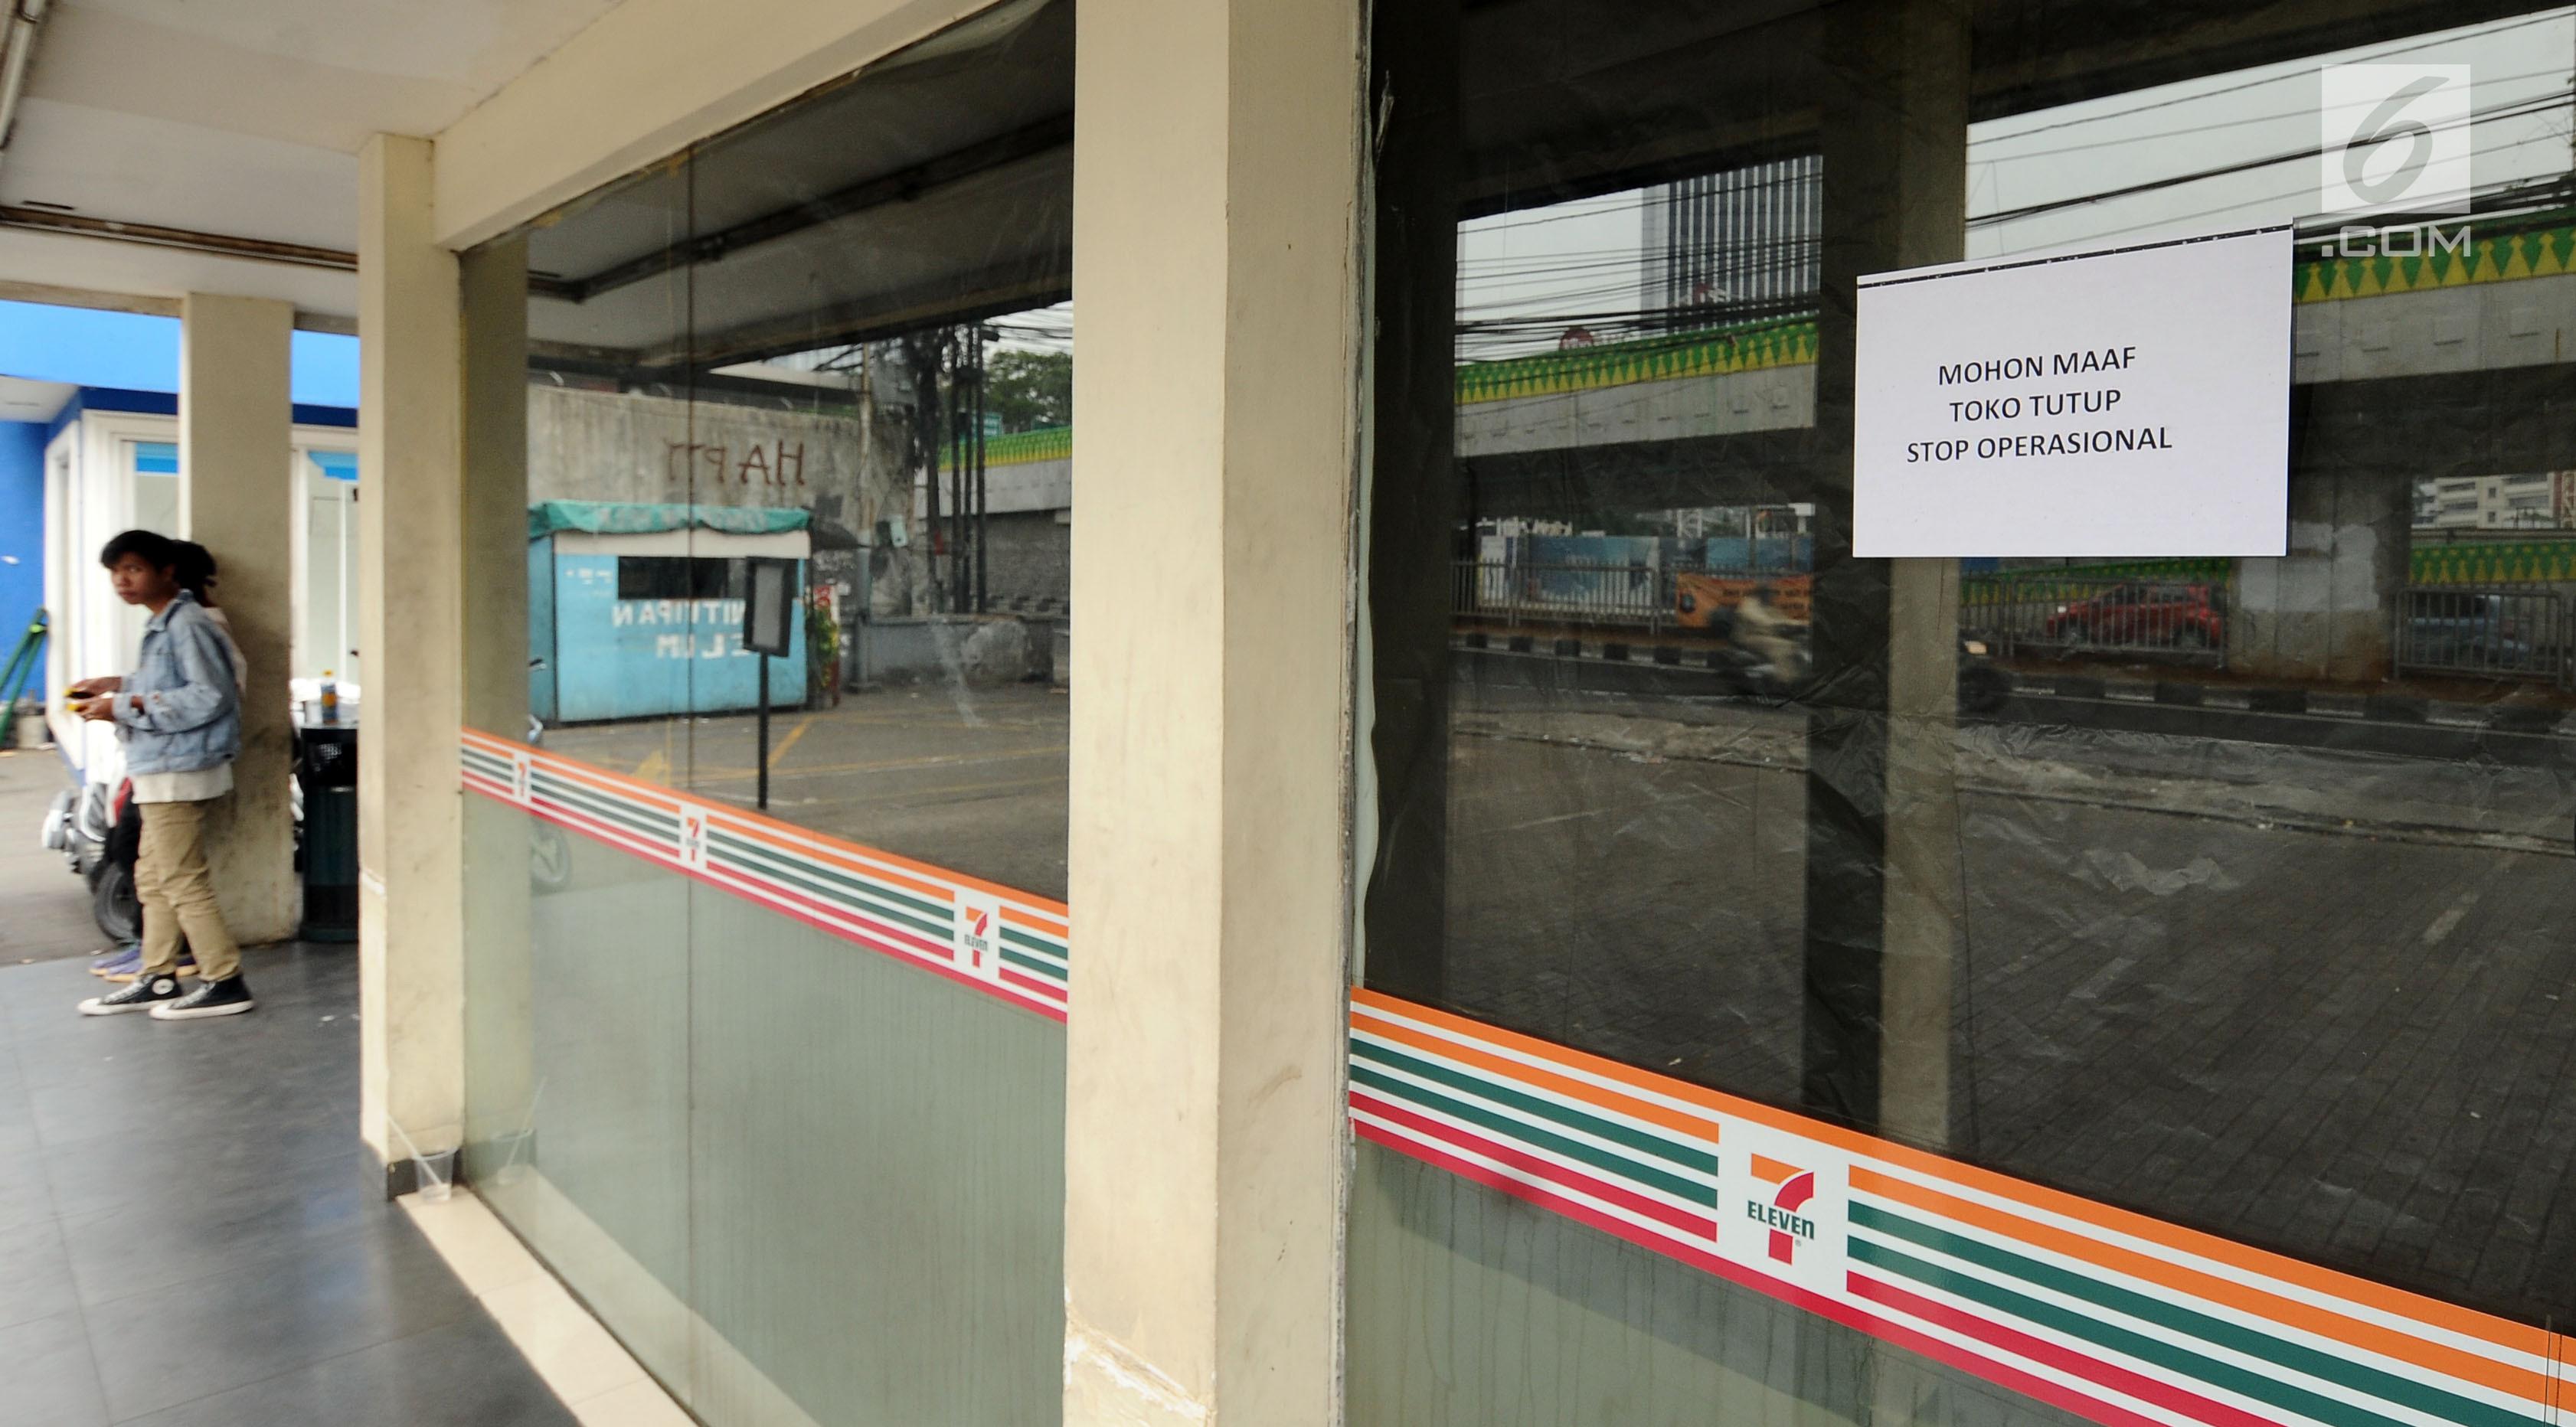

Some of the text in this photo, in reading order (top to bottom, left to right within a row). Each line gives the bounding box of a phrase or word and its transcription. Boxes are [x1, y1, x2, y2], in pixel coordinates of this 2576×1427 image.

[1939, 346, 2136, 386] MOHON MAAF
[1949, 389, 2121, 423] TOKO TUTUP
[1907, 426, 2172, 463] STOP OPERASIONAL
[966, 906, 989, 968] 7
[1751, 1152, 1815, 1266] 7
